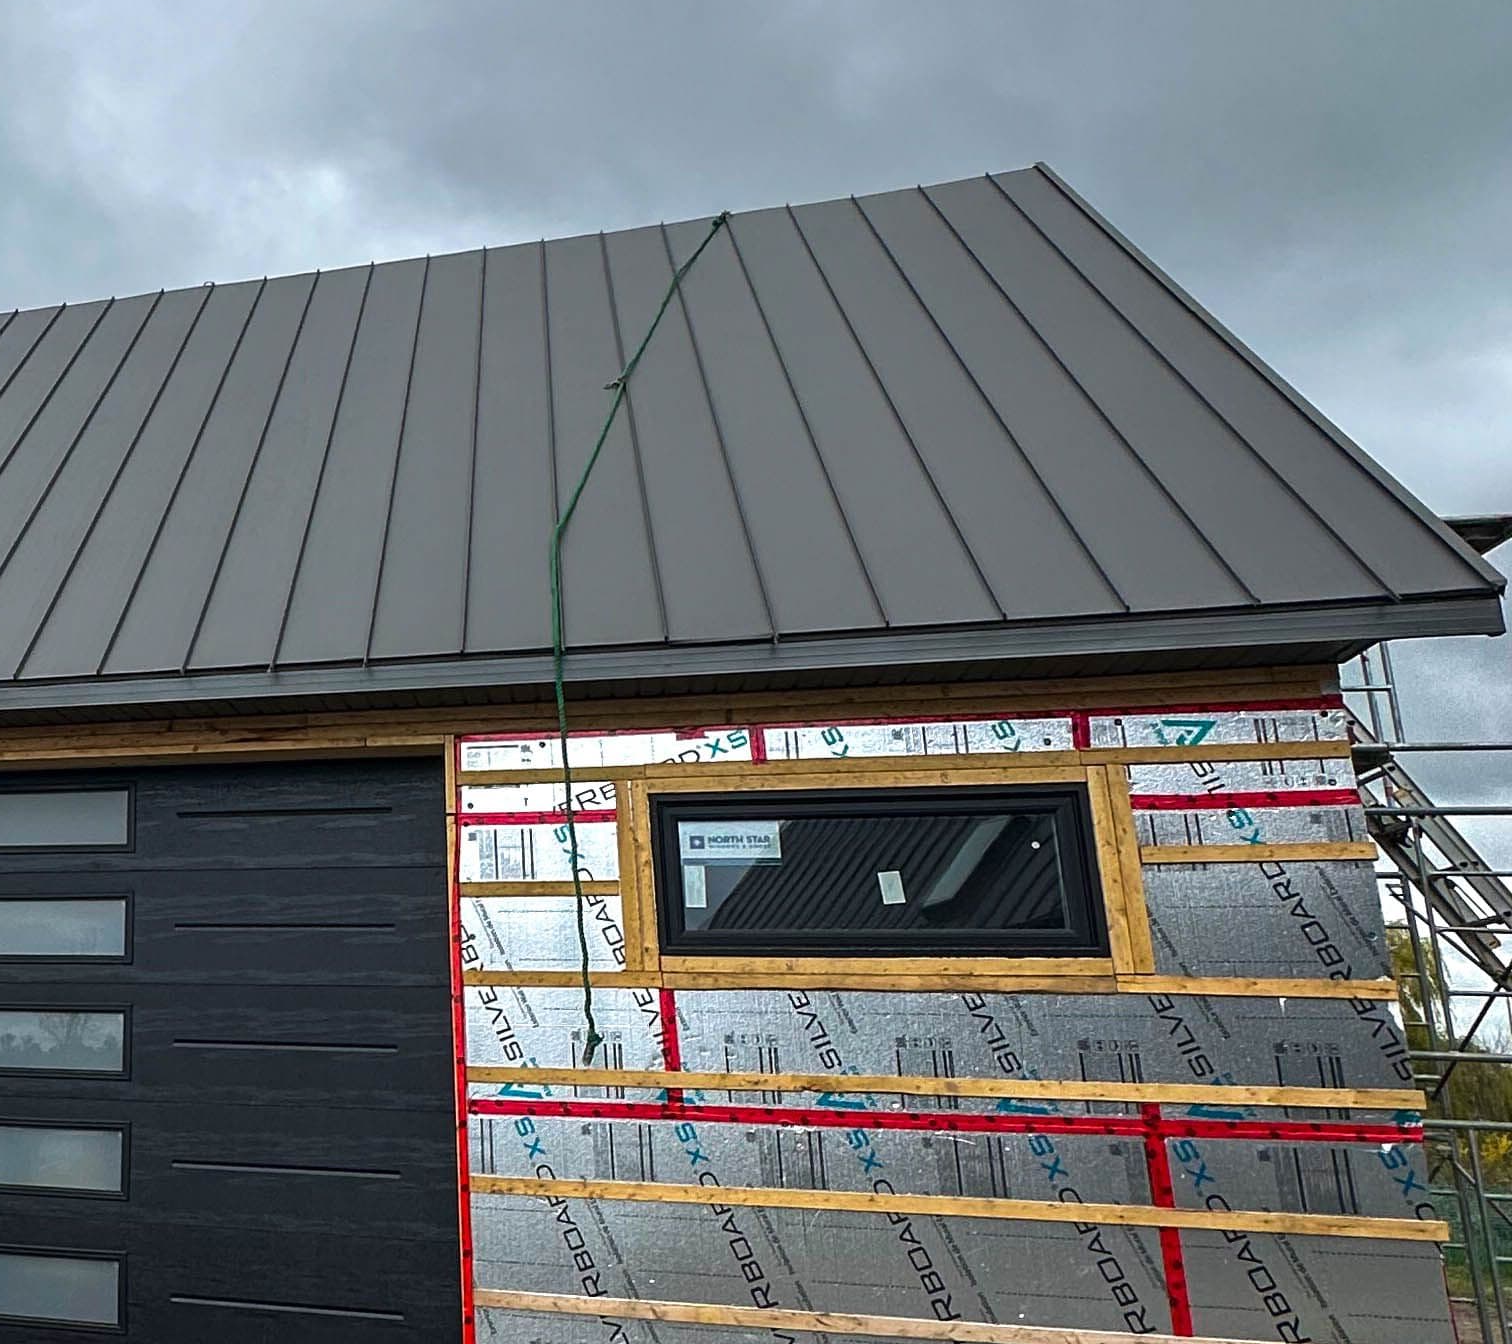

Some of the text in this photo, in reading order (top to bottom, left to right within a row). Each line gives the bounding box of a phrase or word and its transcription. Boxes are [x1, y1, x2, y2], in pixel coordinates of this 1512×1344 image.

[704, 729, 748, 759] XS
[708, 835, 770, 844] NORTH STAR
[514, 1116, 546, 1160] XS
[675, 1122, 710, 1166] XS
[846, 1128, 884, 1174] XS
[1028, 1135, 1069, 1182] XS
[1172, 1140, 1215, 1188] XS
[1378, 1145, 1427, 1197] XS
